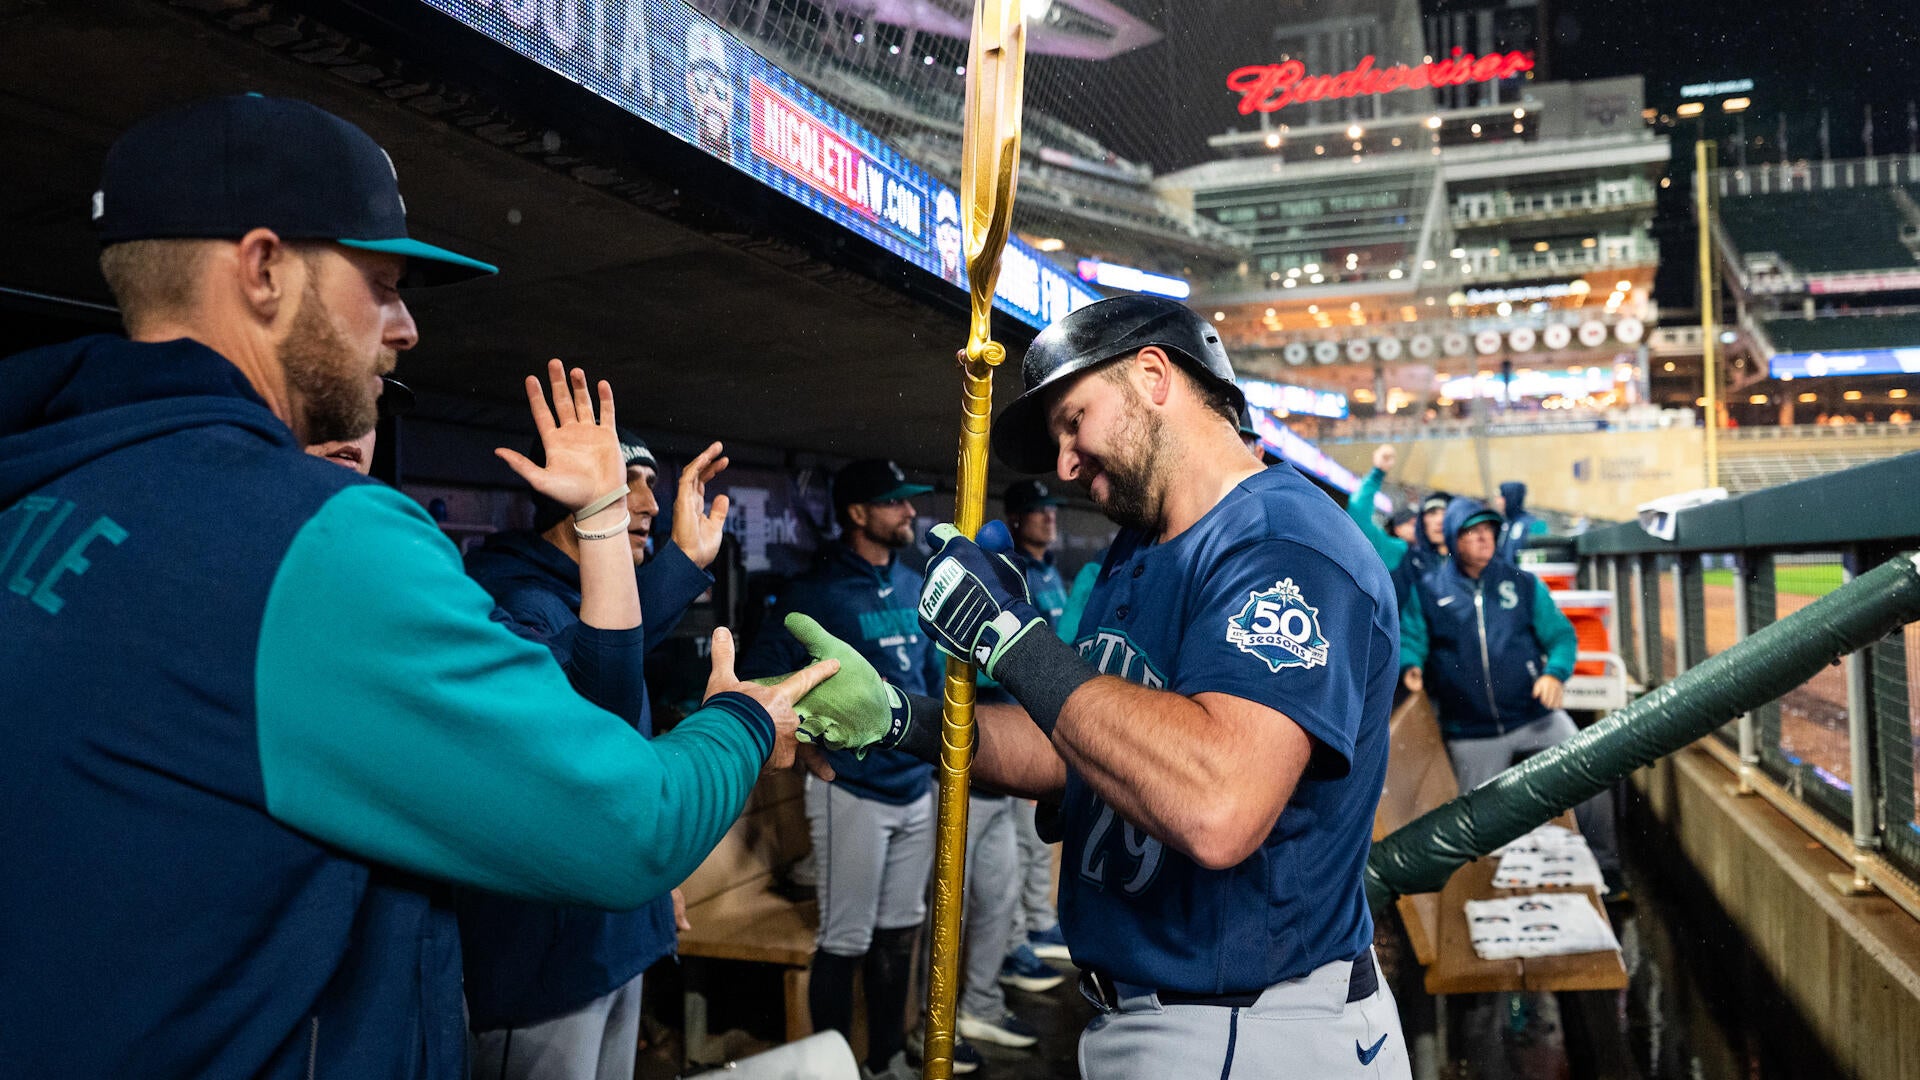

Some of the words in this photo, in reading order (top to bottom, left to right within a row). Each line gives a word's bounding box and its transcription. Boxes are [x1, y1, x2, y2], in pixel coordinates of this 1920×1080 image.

[1226, 46, 1535, 115] Budweiser
[763, 96, 922, 239] NICOLETLAW.COM
[922, 565, 959, 619] franklin
[1249, 634, 1306, 658] seasons
[1251, 600, 1312, 644] 50
[892, 718, 902, 736] 29
